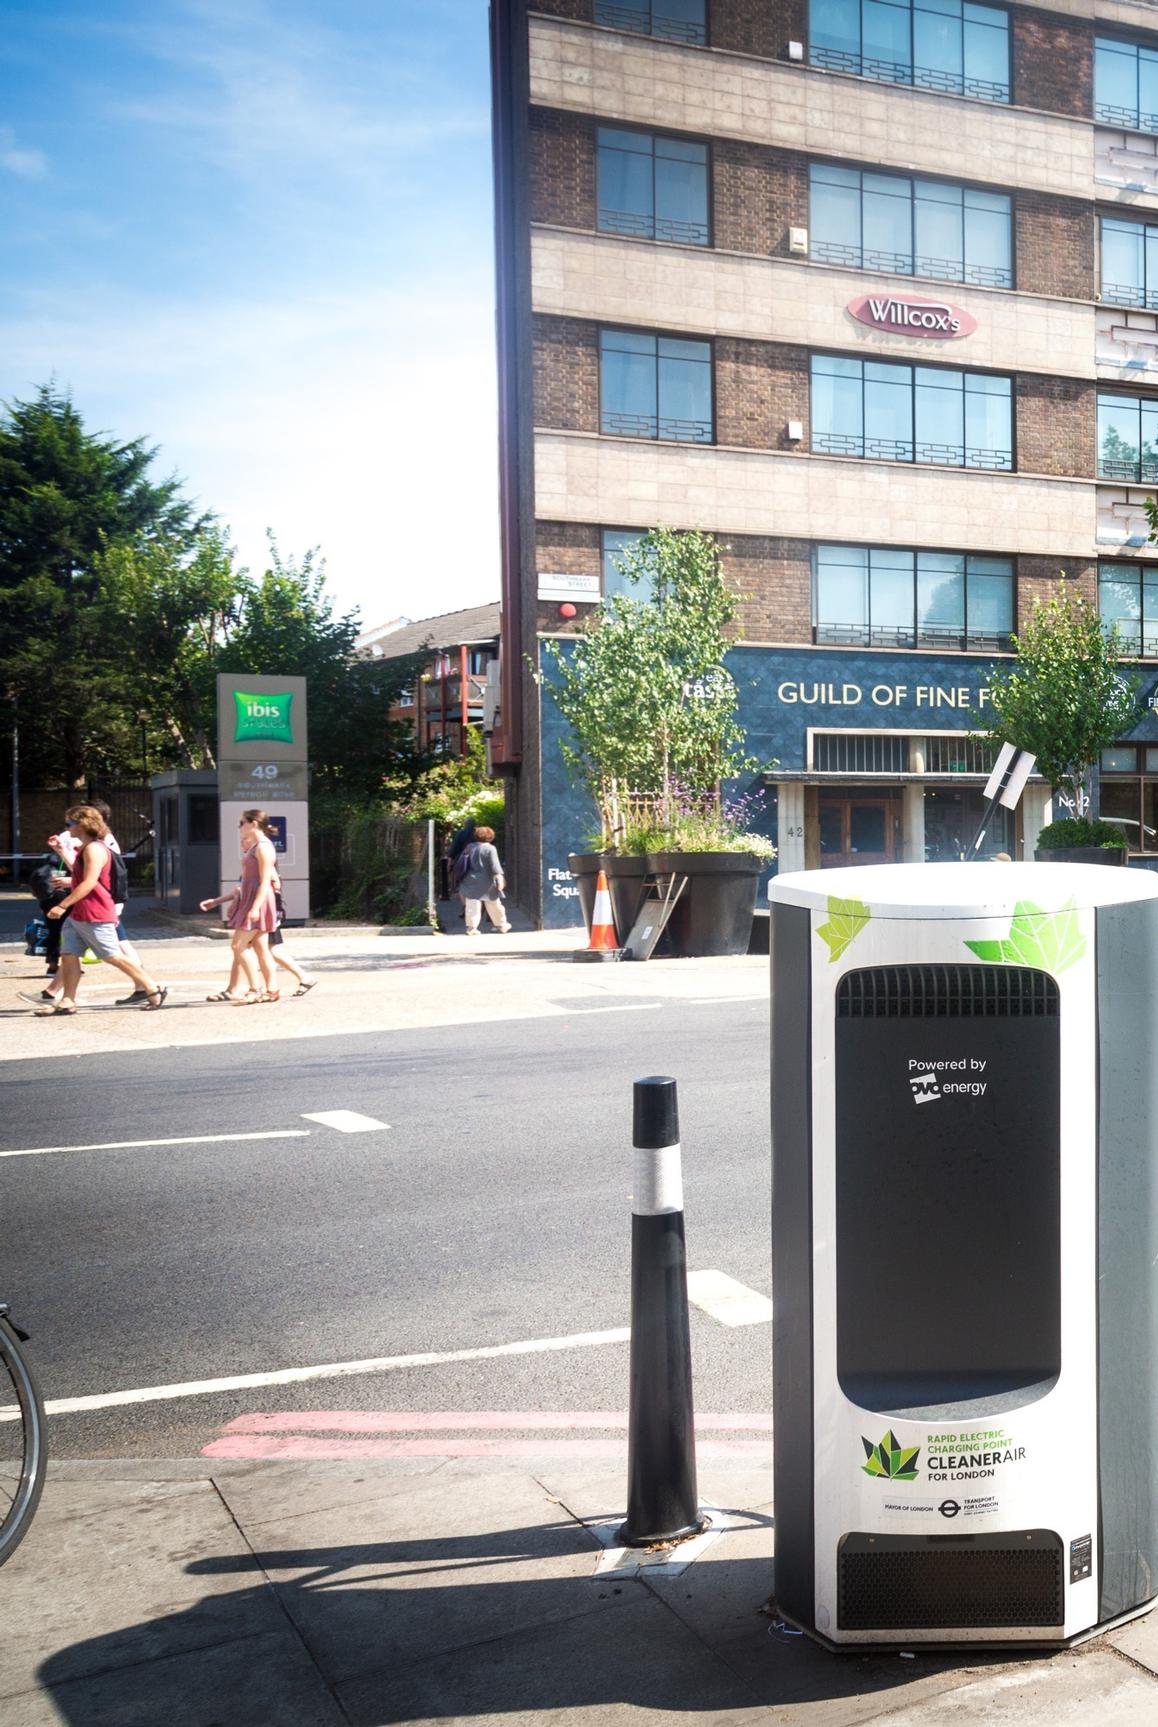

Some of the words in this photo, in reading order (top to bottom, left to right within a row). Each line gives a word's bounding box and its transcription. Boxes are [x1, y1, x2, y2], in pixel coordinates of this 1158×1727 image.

[868, 298, 961, 332] Willcox's
[777, 682, 863, 705] GUILD
[871, 685, 907, 706] OF
[916, 687, 971, 708] FINE
[247, 701, 281, 718] ibis
[251, 764, 278, 780] 49
[552, 883, 580, 900] Squ
[908, 1058, 968, 1071] Powered
[970, 1058, 987, 1072] by
[942, 1082, 987, 1096] energy
[927, 1434, 957, 1443] RAPID
[960, 1429, 1005, 1442] ELECTRIC
[927, 1443, 980, 1454] CHARGING
[982, 1438, 1013, 1450] POINT
[928, 1472, 948, 1481] FOR
[950, 1469, 995, 1481] LONDON
[964, 1496, 995, 1504] TRANSPORT
